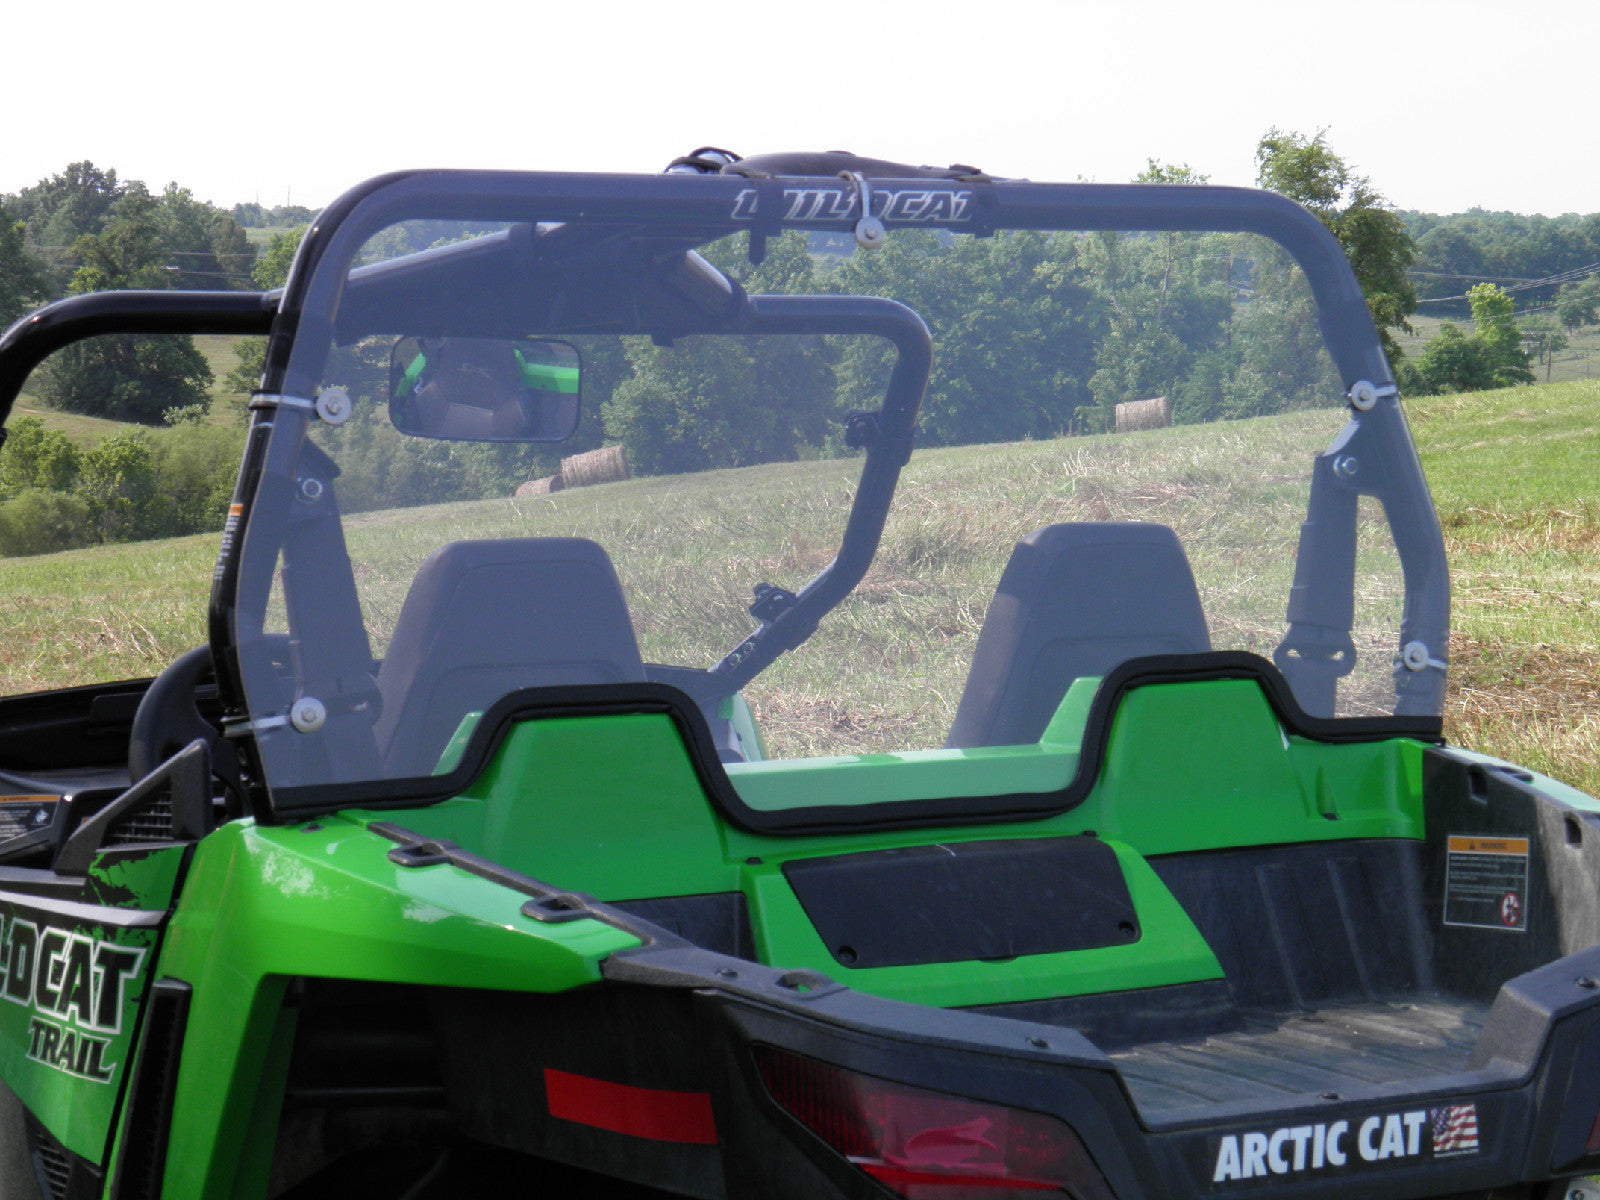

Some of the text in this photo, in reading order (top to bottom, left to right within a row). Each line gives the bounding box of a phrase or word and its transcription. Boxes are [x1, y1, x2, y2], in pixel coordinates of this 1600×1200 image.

[26, 1016, 116, 1084] TRAIL
[1213, 1110, 1427, 1182] ARCTIC CAT
